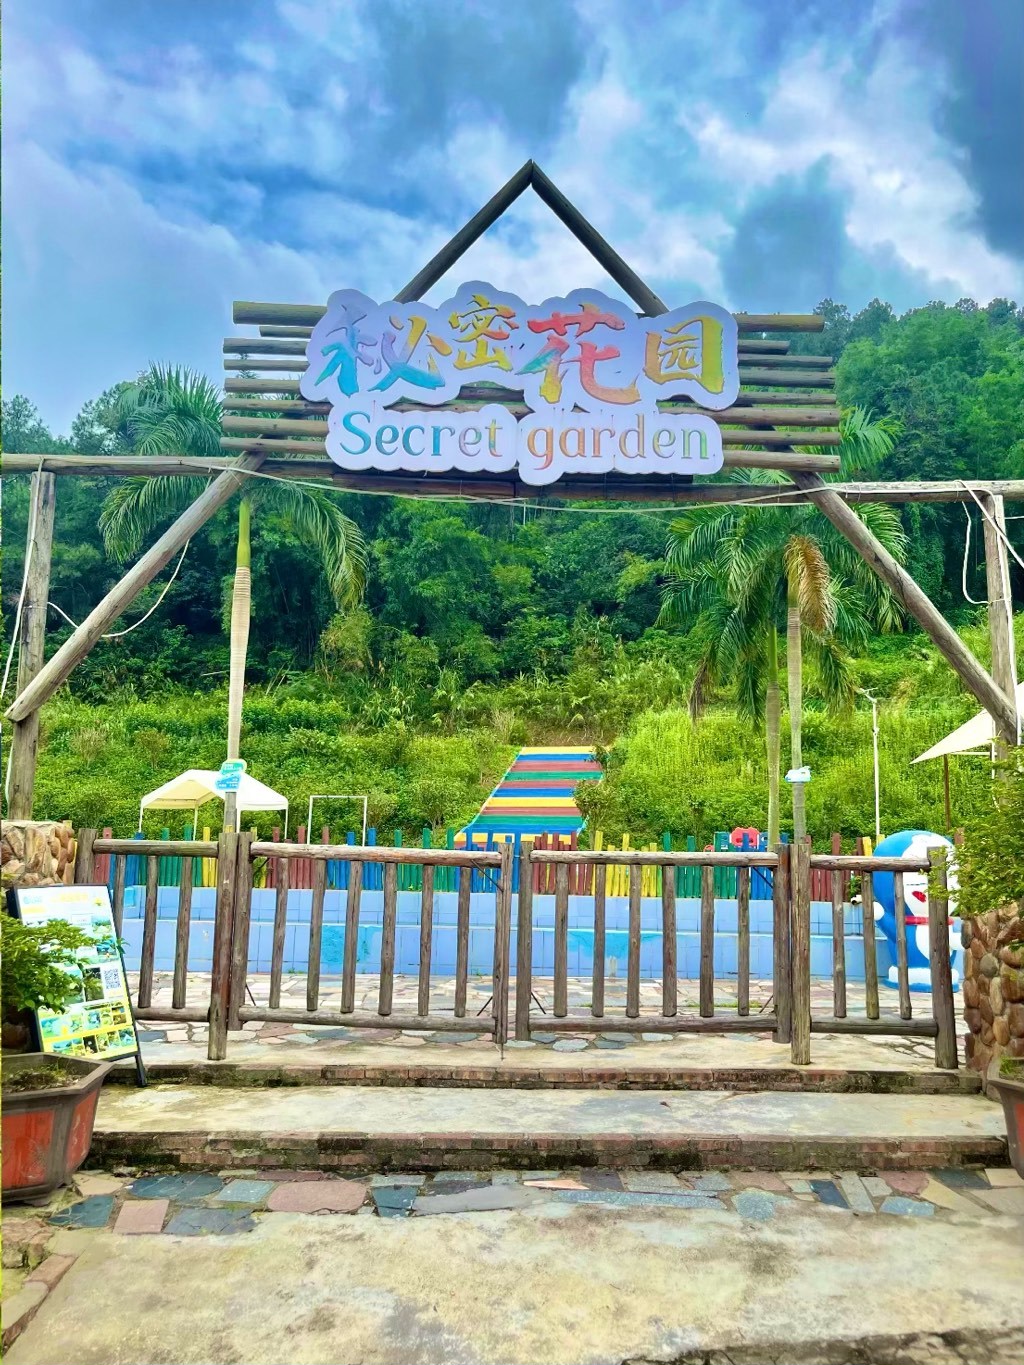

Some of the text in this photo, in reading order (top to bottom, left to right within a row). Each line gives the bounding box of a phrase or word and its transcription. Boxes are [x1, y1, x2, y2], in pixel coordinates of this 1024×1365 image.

[309, 293, 724, 405] 秘密花园
[339, 410, 710, 470] Secret garden
